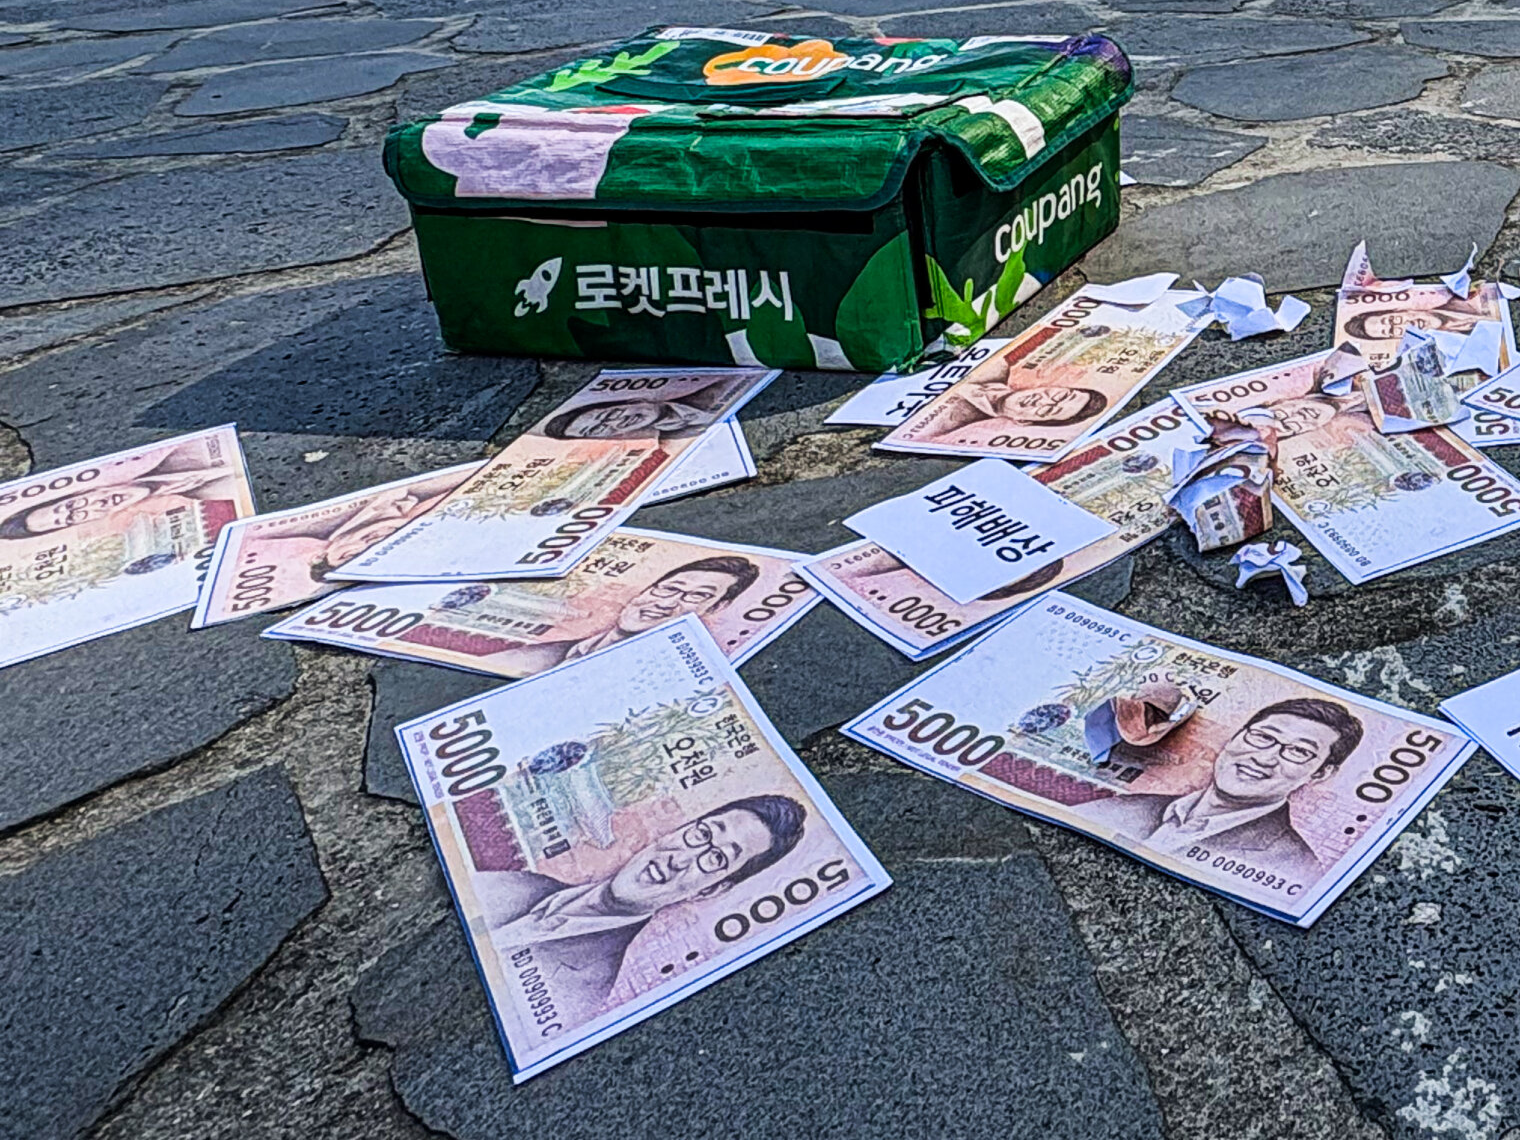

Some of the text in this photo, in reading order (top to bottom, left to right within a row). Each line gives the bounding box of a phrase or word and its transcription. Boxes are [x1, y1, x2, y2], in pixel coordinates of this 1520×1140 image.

[738, 51, 946, 78] coupang
[993, 159, 1105, 264] coupang
[573, 262, 795, 322] 로켓프레시
[1049, 298, 1101, 328] 000
[591, 377, 669, 391] 5000
[987, 435, 1065, 450] 5000
[1292, 453, 1340, 487] 오천원
[522, 506, 610, 564] 5000
[922, 483, 1057, 564] 피해배상
[231, 565, 277, 612] 5000
[742, 578, 811, 623] 000
[305, 601, 425, 638] 5000
[888, 594, 963, 637] 5000
[1063, 613, 1122, 637] 0090993
[1172, 651, 1236, 679] 한국은행
[430, 711, 505, 795] 5000
[714, 714, 758, 758] 한국은행
[879, 702, 1007, 764] 5000
[662, 735, 715, 787] 오천원
[1355, 732, 1441, 804] 5000
[1186, 846, 1212, 863] BD
[1211, 856, 1285, 891] 0090993
[712, 861, 851, 942] 5000
[517, 967, 553, 1027] 0090993
